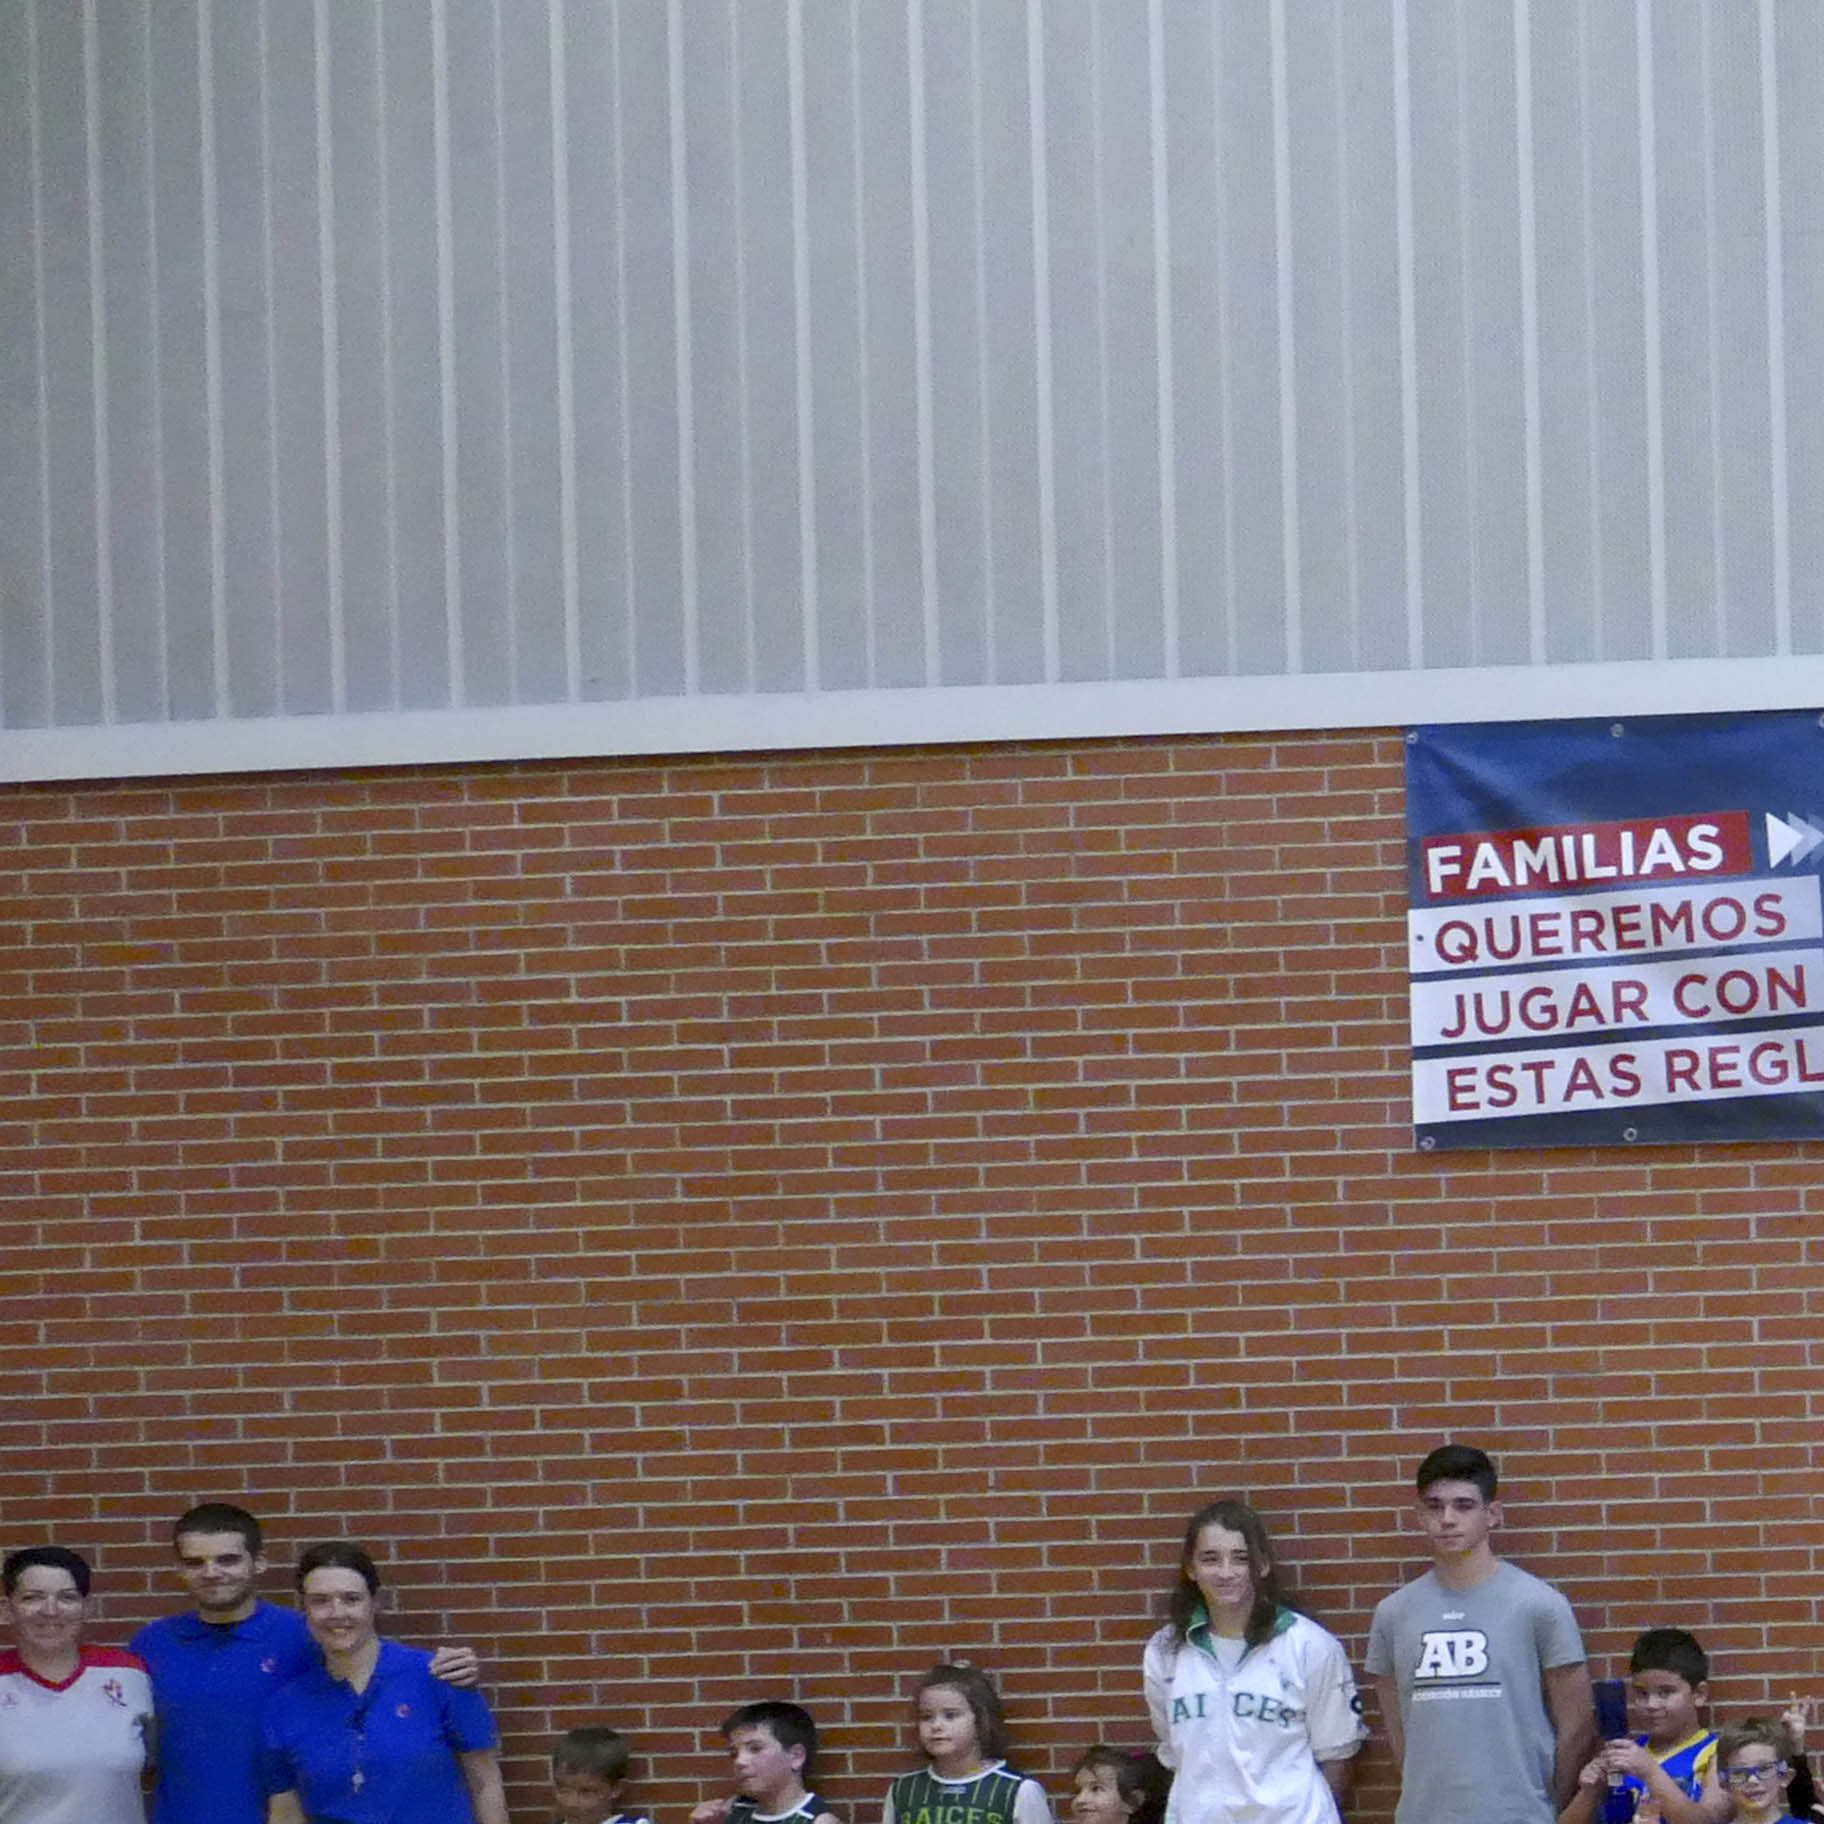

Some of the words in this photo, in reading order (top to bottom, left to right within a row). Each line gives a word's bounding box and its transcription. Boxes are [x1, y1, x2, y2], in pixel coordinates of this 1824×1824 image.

[1427, 824, 1725, 893] FAMILIAS
[1435, 893, 1787, 965] QUEREMOS
[1441, 980, 1649, 1038] JUGAR
[1673, 964, 1807, 1018] CON
[1447, 1054, 1642, 1112] ESTAS
[1415, 1629, 1490, 1679] AB
